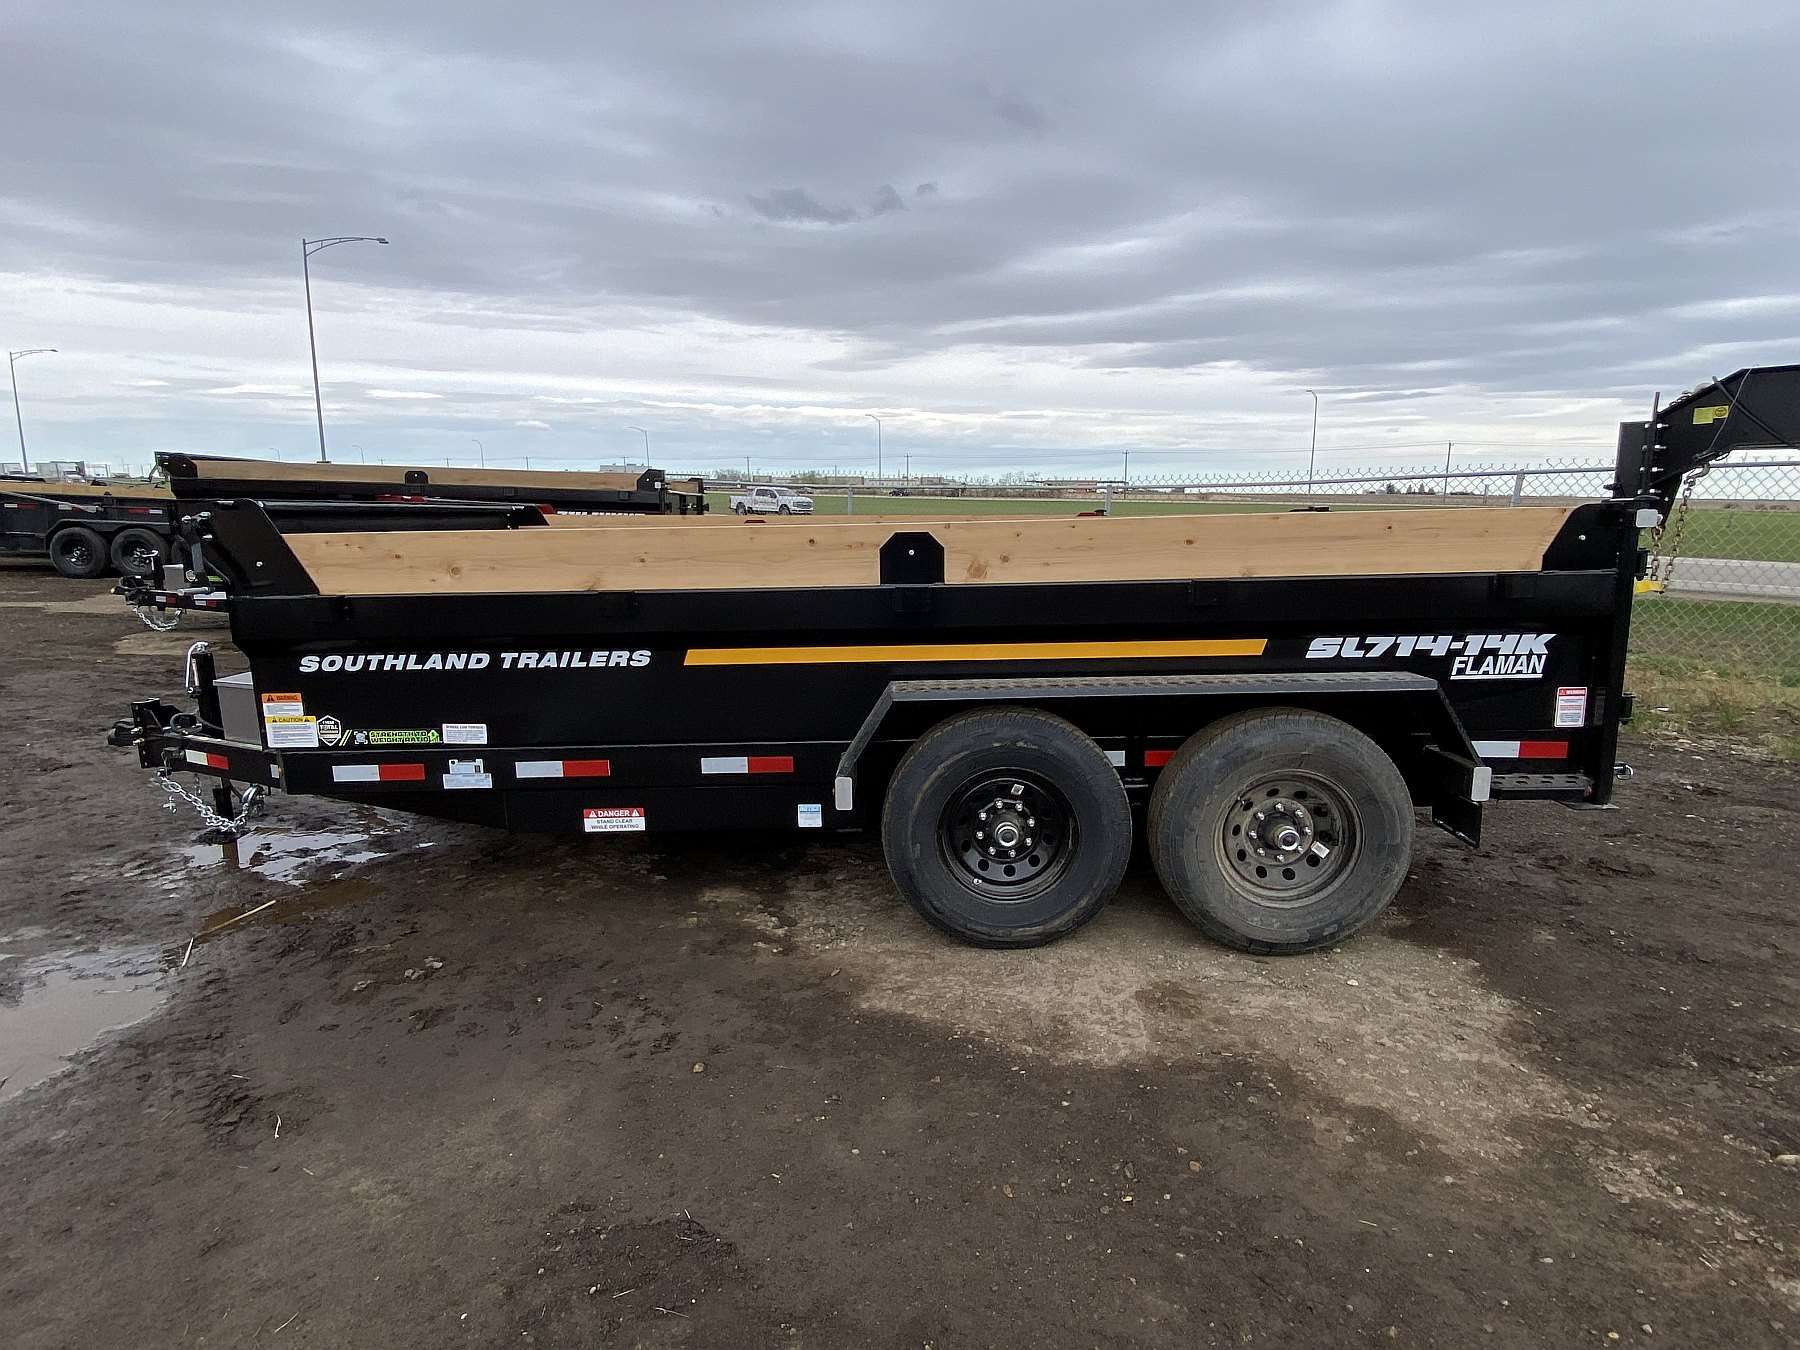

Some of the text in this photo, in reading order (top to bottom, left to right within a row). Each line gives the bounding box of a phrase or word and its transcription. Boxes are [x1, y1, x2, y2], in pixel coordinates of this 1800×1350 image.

[1305, 634, 1557, 659] SL714-14K
[299, 650, 652, 673] SOUTHLAND TRAILERS
[1451, 655, 1547, 676] FLAMAN
[597, 810, 631, 818] DANGER
